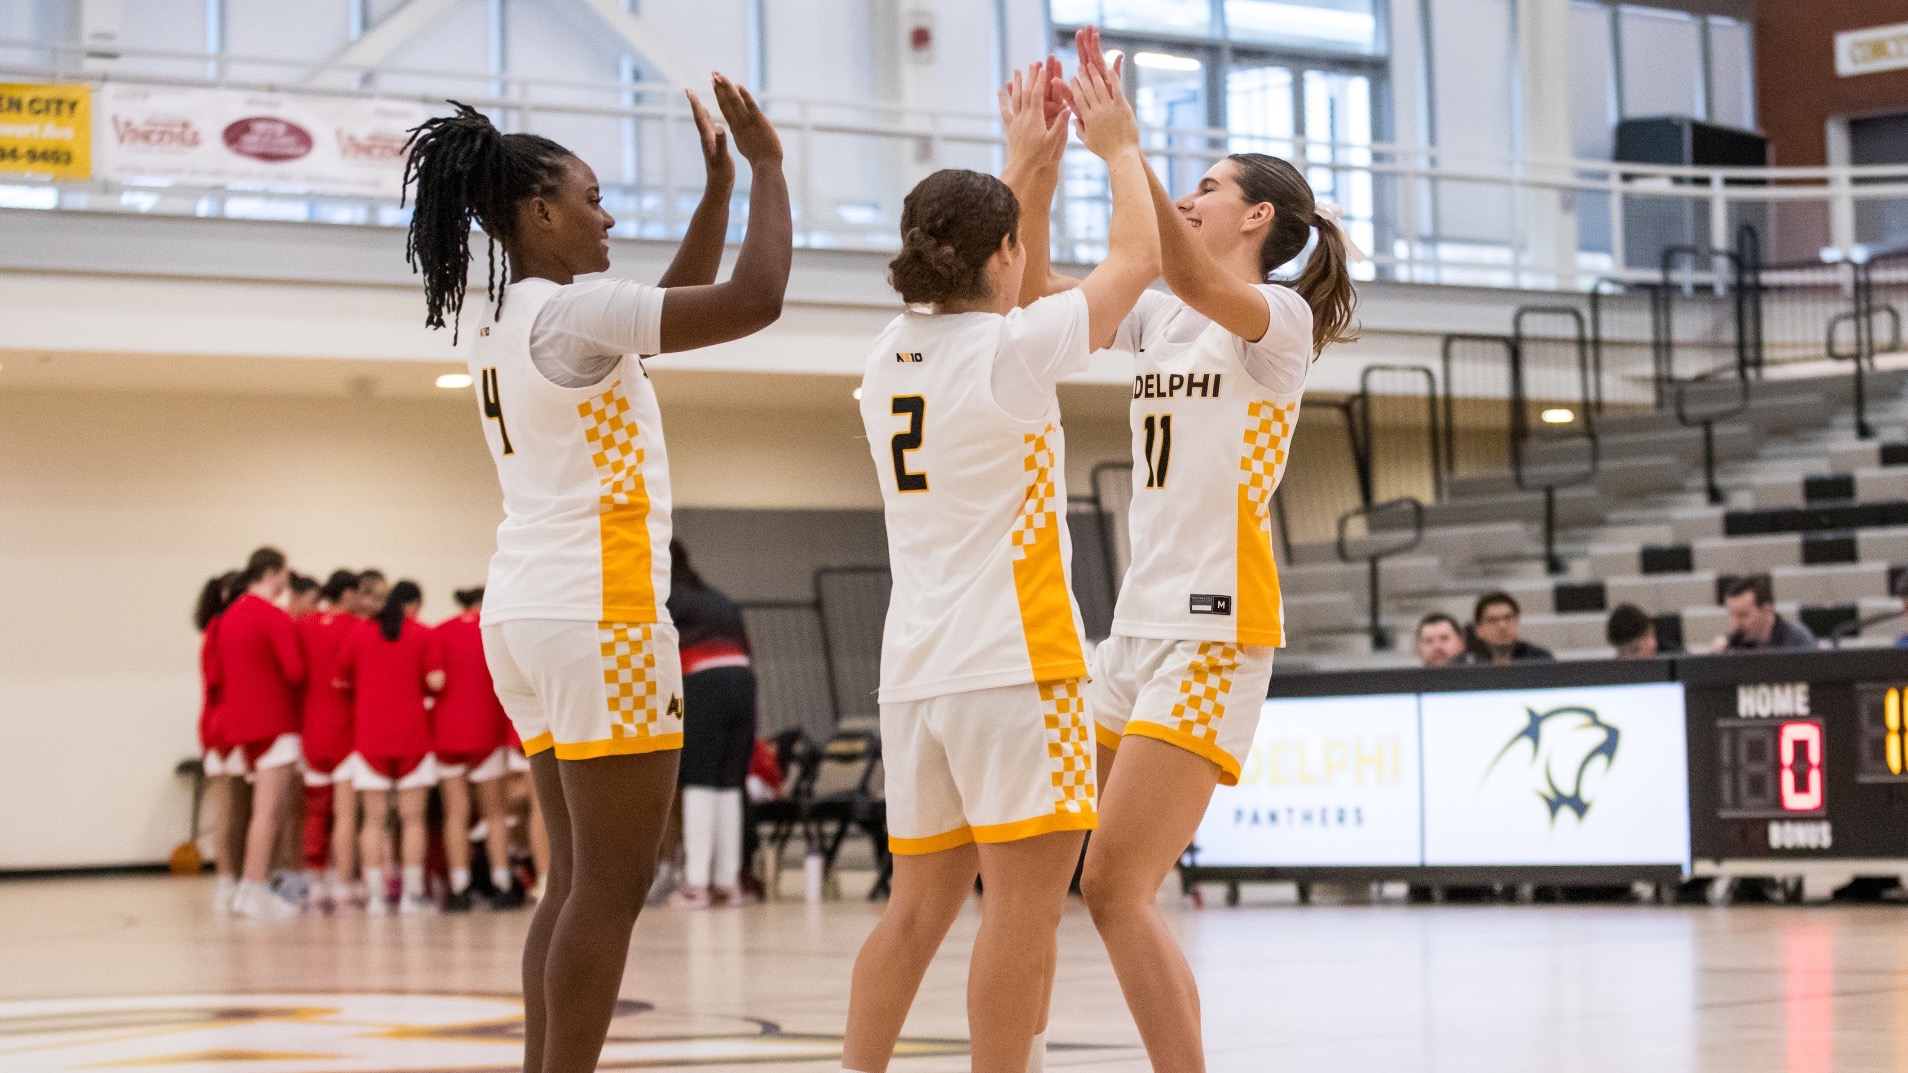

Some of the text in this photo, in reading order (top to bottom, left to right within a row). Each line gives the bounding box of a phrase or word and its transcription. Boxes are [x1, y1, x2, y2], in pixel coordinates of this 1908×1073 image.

[0, 95, 78, 116] N CITY
[482, 366, 515, 456] 4
[891, 394, 929, 493] 2
[1144, 413, 1172, 490] 11
[1217, 600, 1226, 610] M
[1737, 682, 1810, 719] HOME
[1884, 686, 1908, 776] 1
[1779, 720, 1824, 812] 0
[1234, 806, 1364, 828] PANTHERS
[1768, 819, 1833, 850] BONUS
